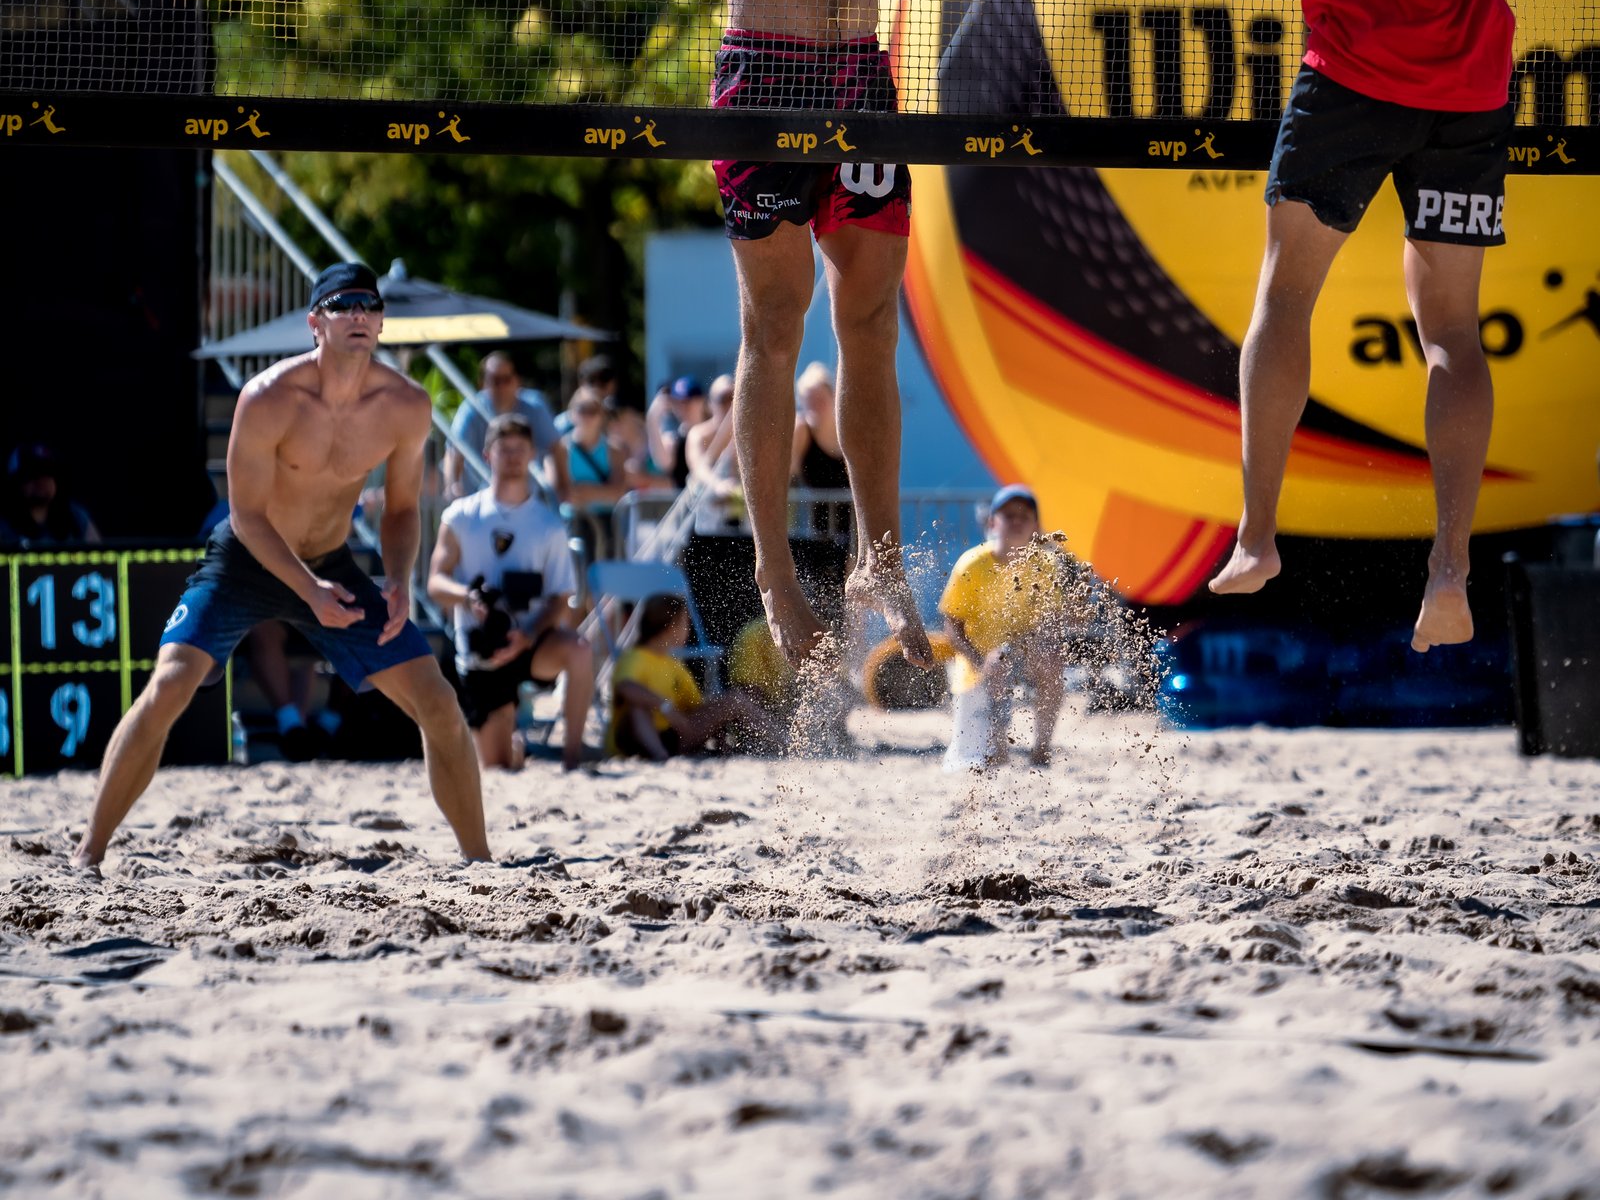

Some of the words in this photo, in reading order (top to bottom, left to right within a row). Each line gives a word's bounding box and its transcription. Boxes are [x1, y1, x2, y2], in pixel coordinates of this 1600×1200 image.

[185, 119, 228, 141] avp
[388, 124, 429, 145] avp
[585, 129, 626, 150] avp
[777, 133, 818, 154] avp
[965, 137, 1005, 158] avp
[1149, 141, 1187, 162] avp
[27, 571, 117, 649] 13
[50, 681, 91, 757] 9
